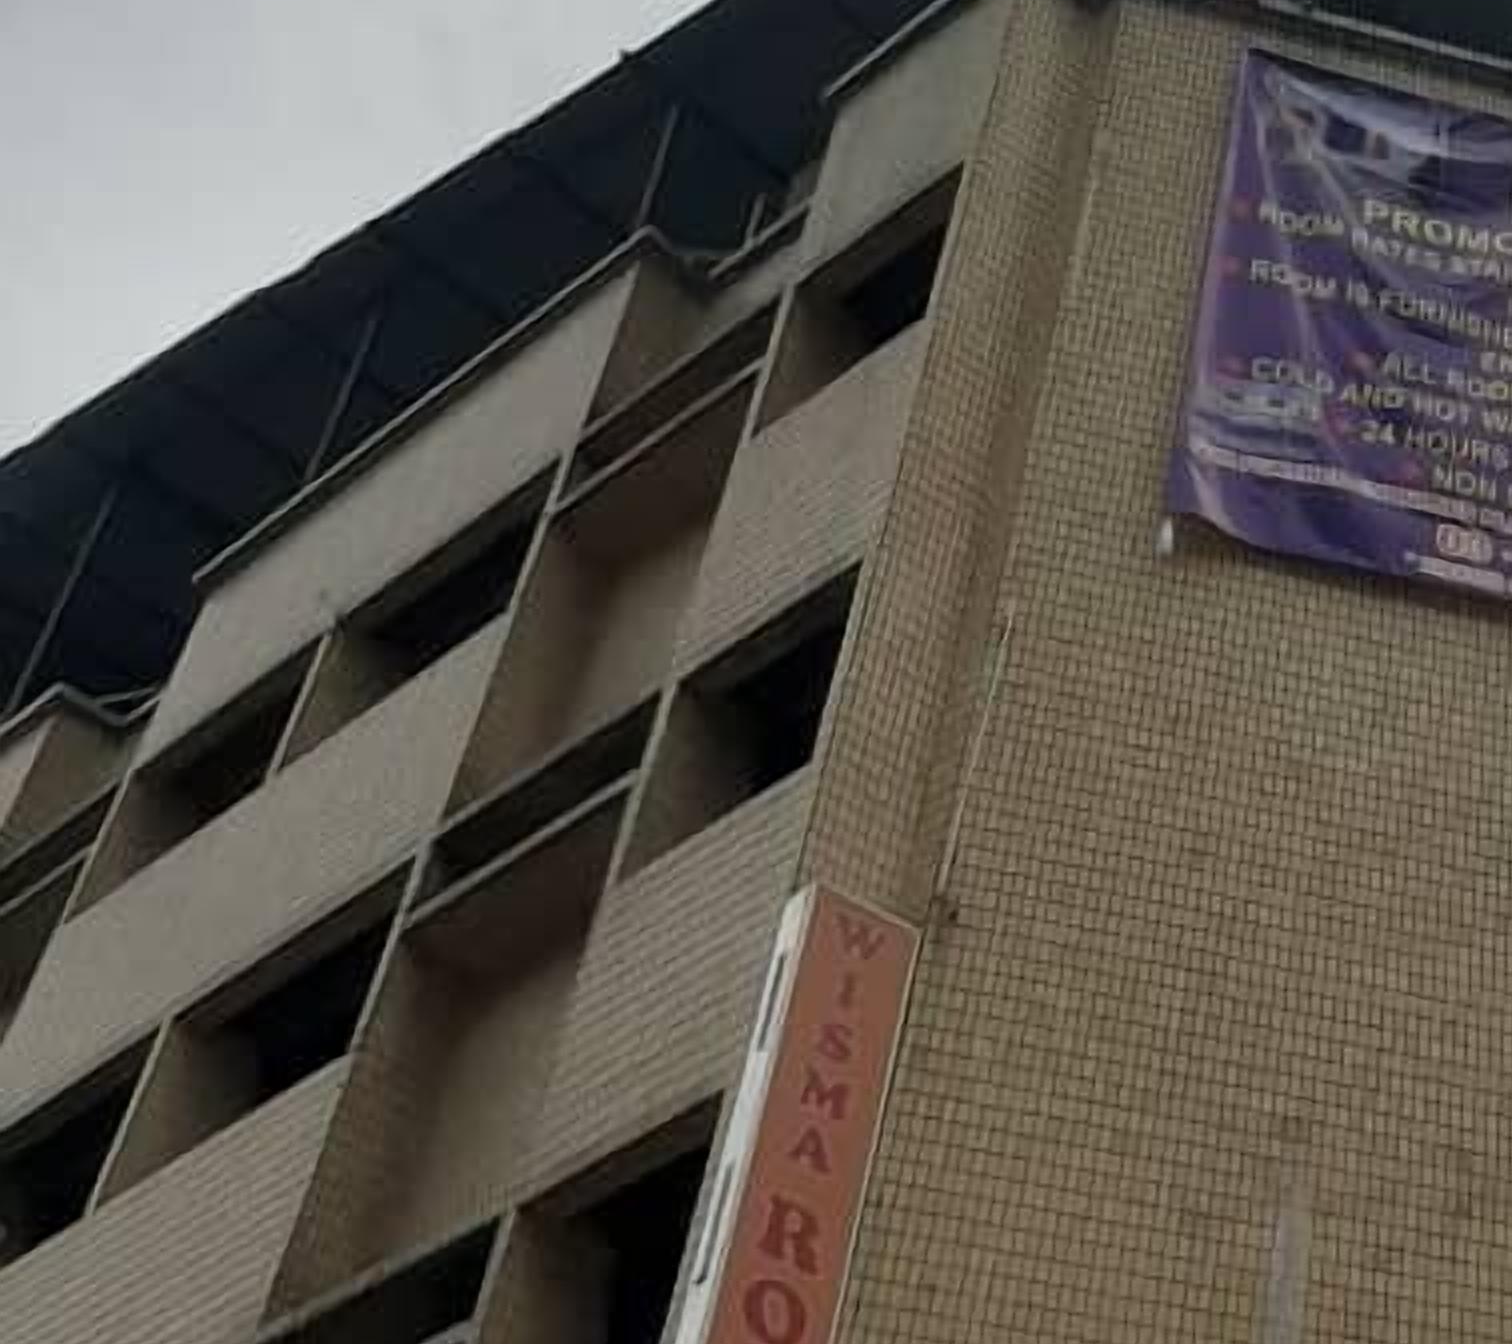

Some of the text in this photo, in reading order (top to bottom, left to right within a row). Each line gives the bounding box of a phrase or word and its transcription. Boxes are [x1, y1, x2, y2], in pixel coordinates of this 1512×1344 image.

[1247, 256, 1337, 304] ROOM
[1250, 352, 1336, 397] COLD
[1381, 345, 1437, 386] ALL
[788, 910, 886, 1175] WISMA
